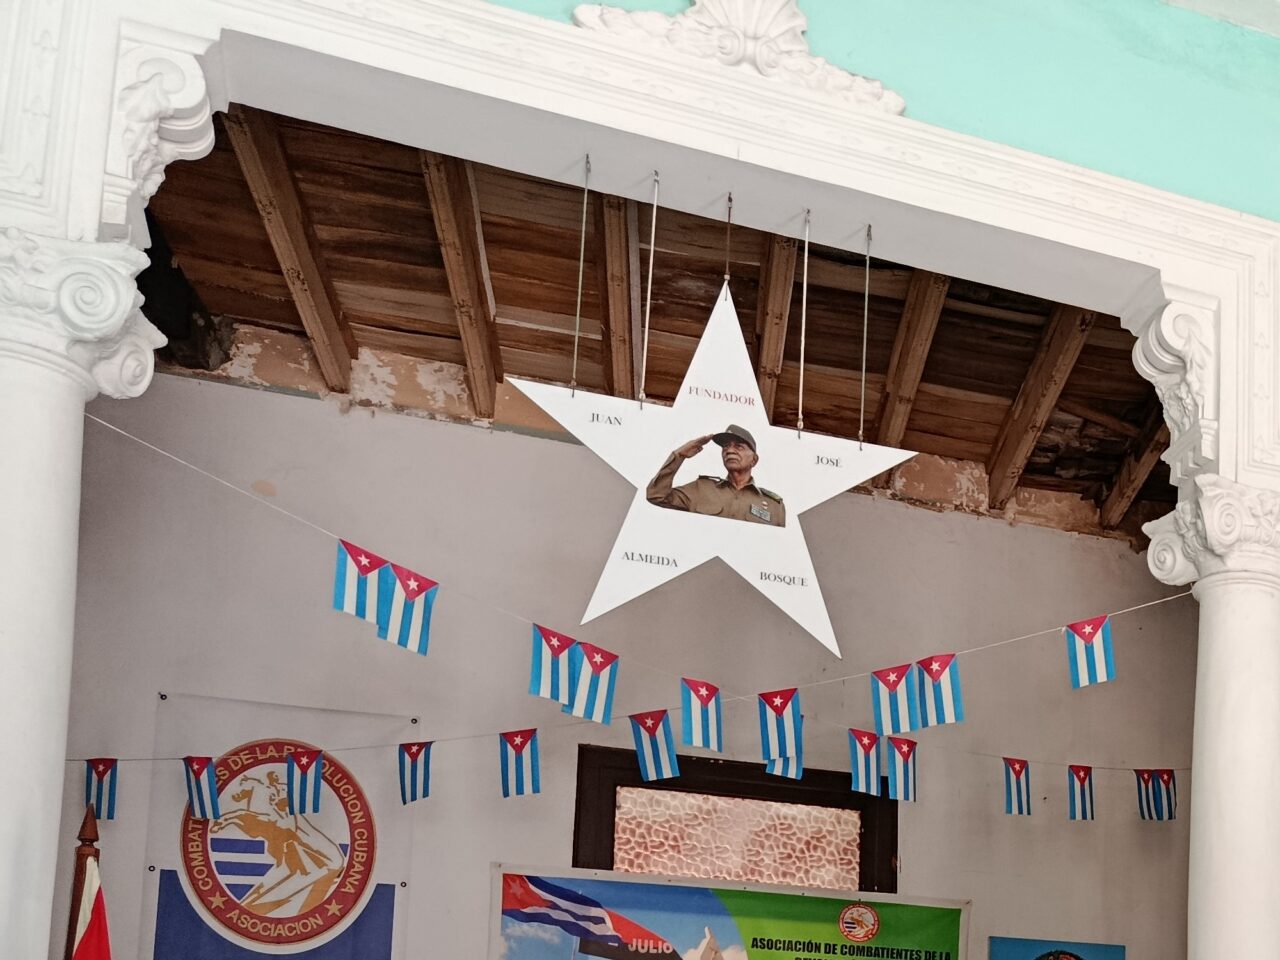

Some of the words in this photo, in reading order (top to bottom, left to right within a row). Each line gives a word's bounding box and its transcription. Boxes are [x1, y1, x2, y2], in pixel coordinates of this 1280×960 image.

[688, 386, 755, 407] FUNDADOR
[589, 412, 623, 426] JUAN
[815, 455, 843, 468] JOSÉ
[621, 551, 679, 568] ALMEIDA
[759, 571, 809, 587] BOSQUE
[227, 753, 254, 770] DE
[256, 745, 279, 759] LA
[341, 828, 368, 895] CUBANA
[226, 908, 324, 937] ASOCIACION
[627, 938, 674, 954] JULIO
[750, 936, 822, 954] ASOCIACIÓN
[823, 942, 838, 956] DE
